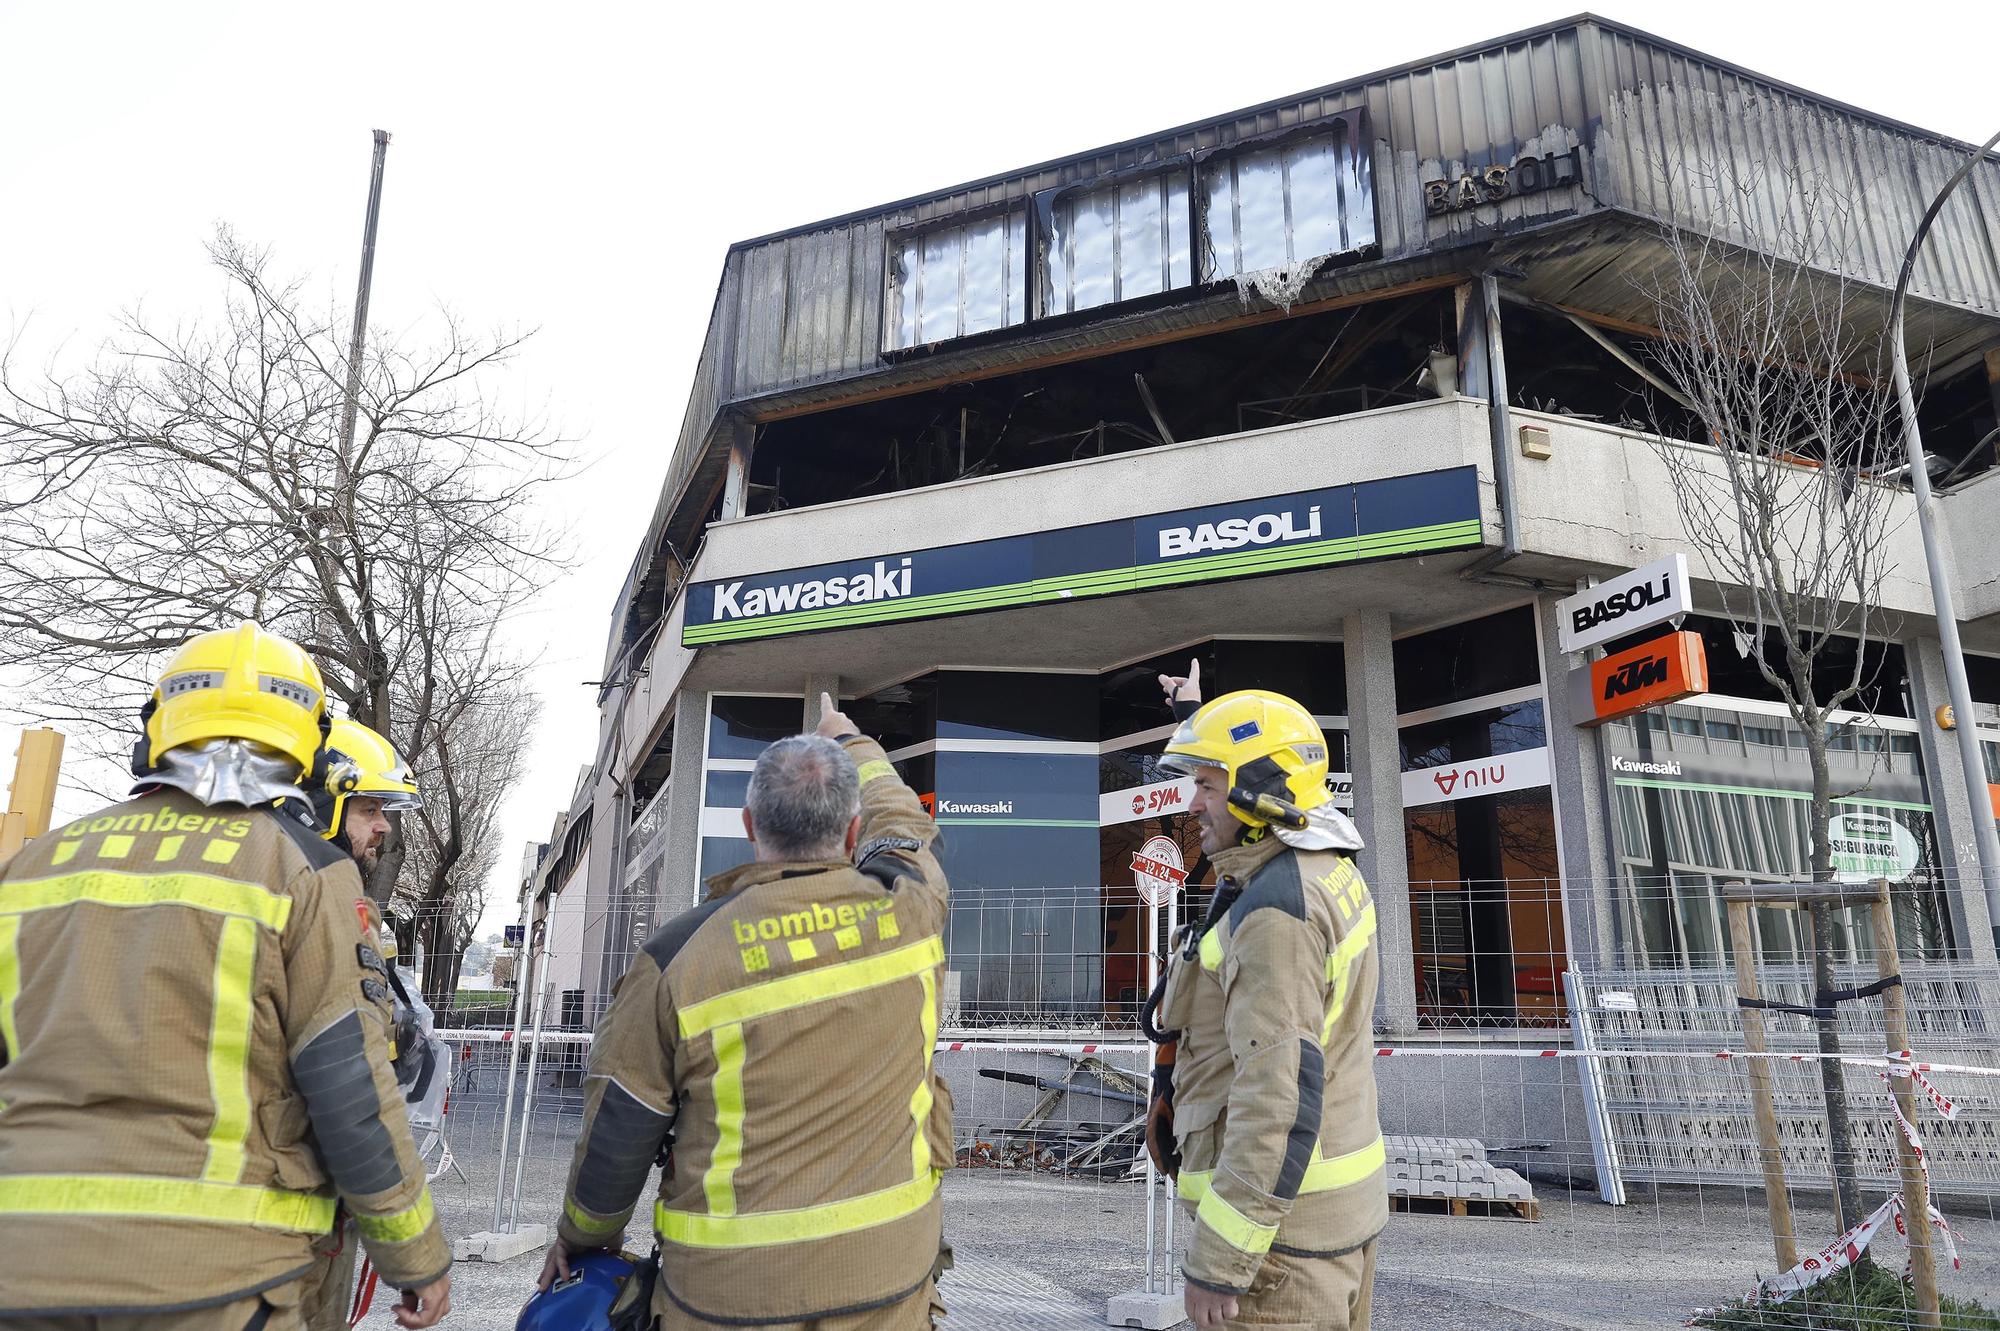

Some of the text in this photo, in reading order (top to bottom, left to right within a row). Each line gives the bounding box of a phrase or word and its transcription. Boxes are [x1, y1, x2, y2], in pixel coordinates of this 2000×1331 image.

[712, 557, 913, 621] Kawasaki
[1604, 655, 1668, 700] KTM
[1612, 755, 1682, 777] Kawasaki
[938, 800, 1013, 814] Kawasaki
[1148, 786, 1182, 812] SYM
[1846, 820, 1889, 834] Kawasaki
[732, 897, 894, 945] bombers
